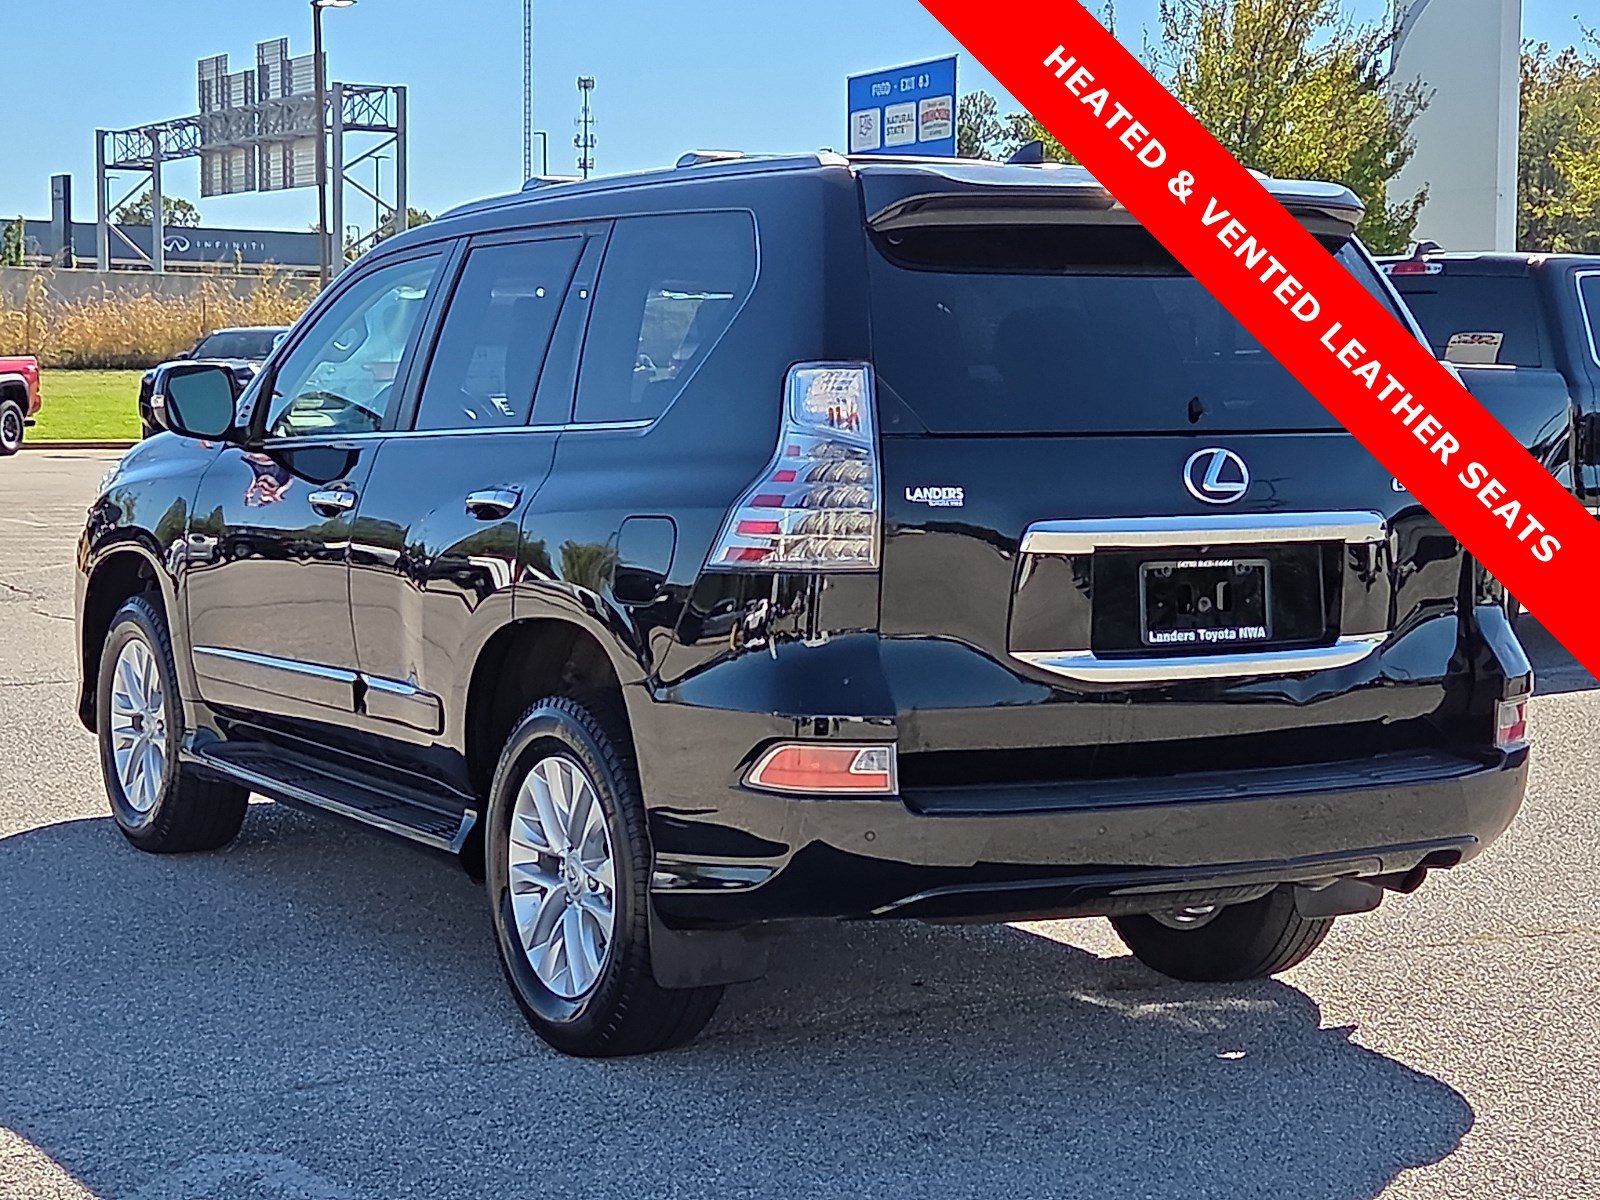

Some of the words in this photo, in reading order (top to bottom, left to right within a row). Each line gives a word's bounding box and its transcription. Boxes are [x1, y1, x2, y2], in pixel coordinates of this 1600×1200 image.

[196, 239, 265, 251] INFINITI
[905, 487, 964, 501] LANDERS
[1149, 630, 1195, 643] Landers
[1197, 628, 1236, 643] Toyota
[1238, 626, 1266, 639] NWA
